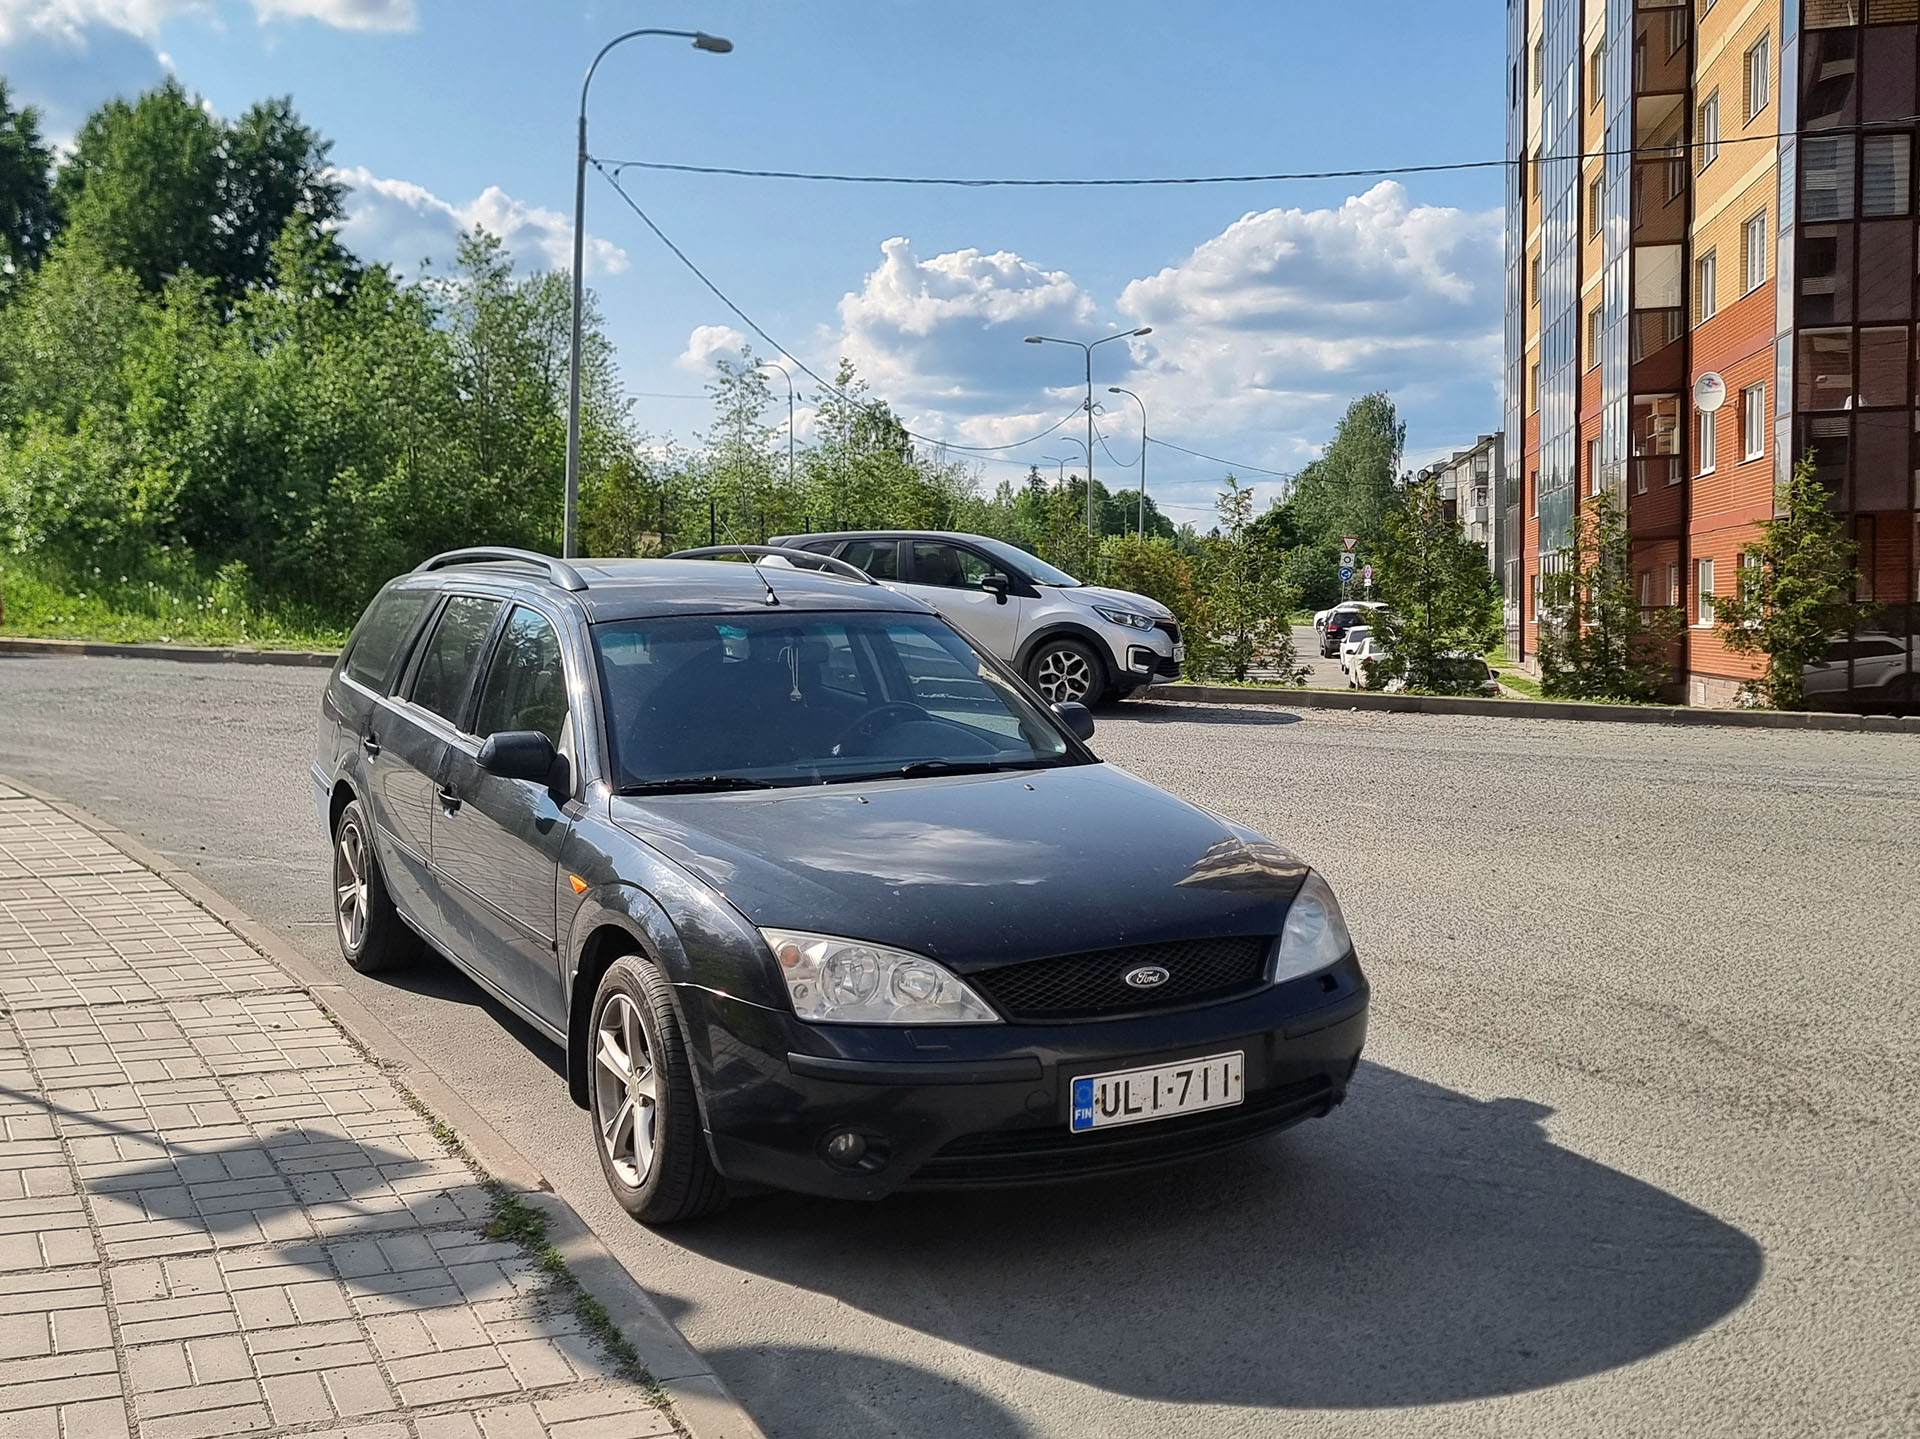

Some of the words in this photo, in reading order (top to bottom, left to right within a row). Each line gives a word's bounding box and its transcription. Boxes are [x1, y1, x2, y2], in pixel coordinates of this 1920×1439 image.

[1137, 971, 1160, 984] Ford
[1101, 1063, 1229, 1118] ULI-711
[1075, 1107, 1093, 1120] FIN
